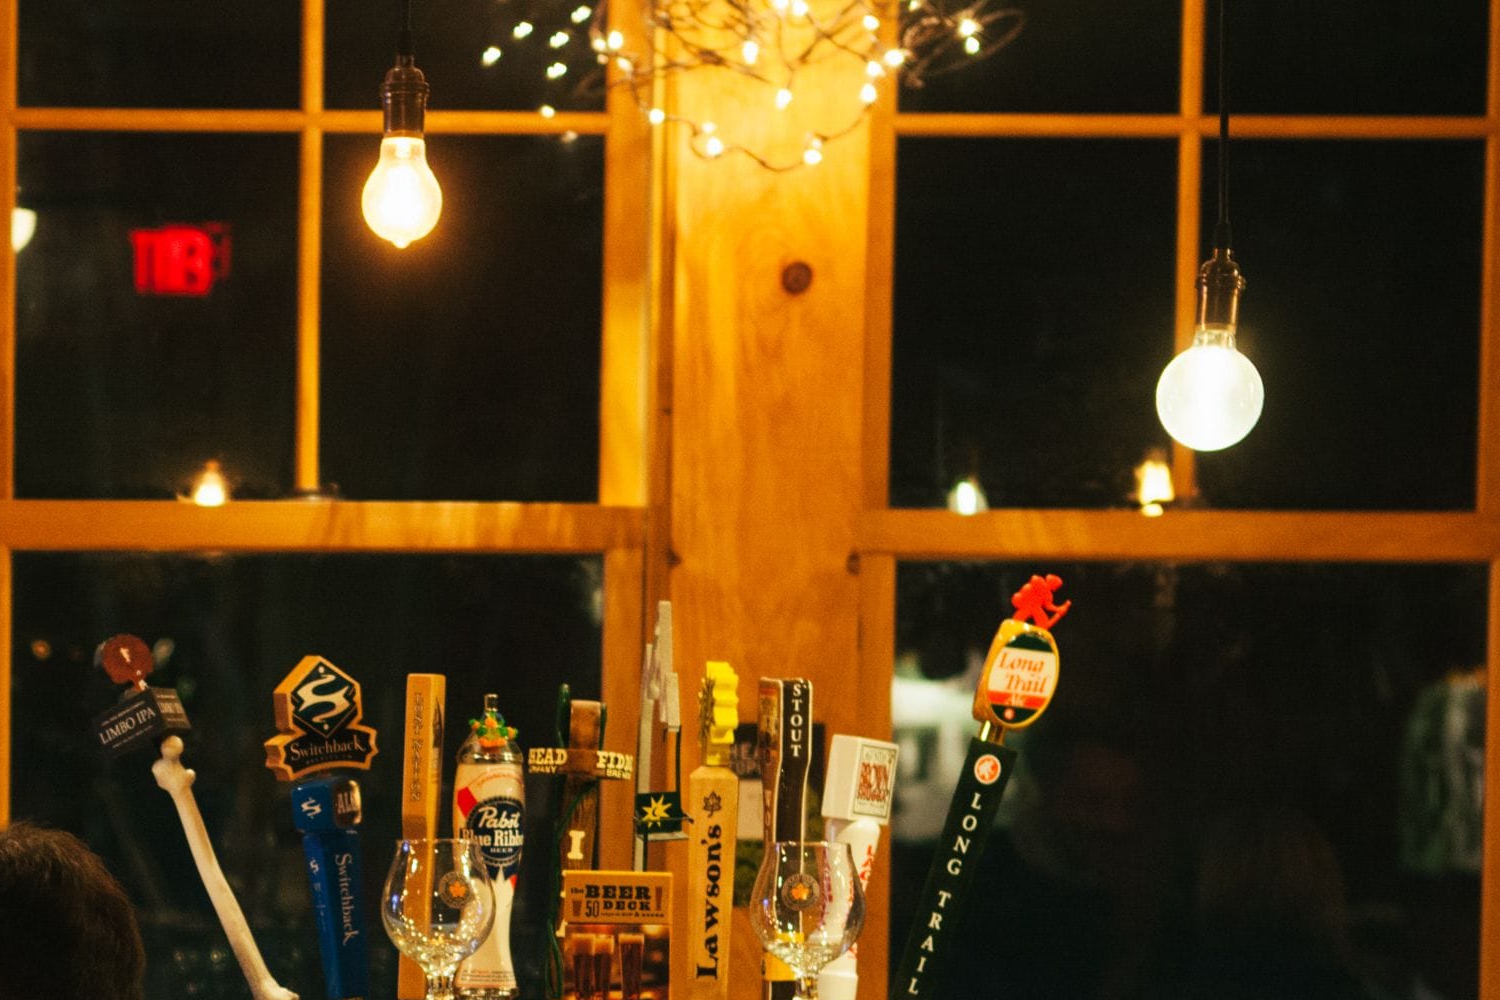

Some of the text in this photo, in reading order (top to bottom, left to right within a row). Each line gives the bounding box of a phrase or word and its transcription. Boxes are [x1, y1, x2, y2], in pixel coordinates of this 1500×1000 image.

[999, 652, 1045, 679] Long
[1006, 672, 1048, 693] Trail
[99, 716, 136, 744] LIMBO
[135, 706, 156, 725] IPA
[790, 683, 803, 757] STOUT
[290, 734, 366, 762] Switchback
[478, 806, 521, 828] Pabst
[335, 852, 359, 946] Switchback
[570, 884, 652, 900] the BEER
[696, 824, 722, 980] Lawson's
[908, 792, 983, 995] LONG TRAIL
[585, 900, 600, 918] 50
[603, 900, 651, 911] DECK
